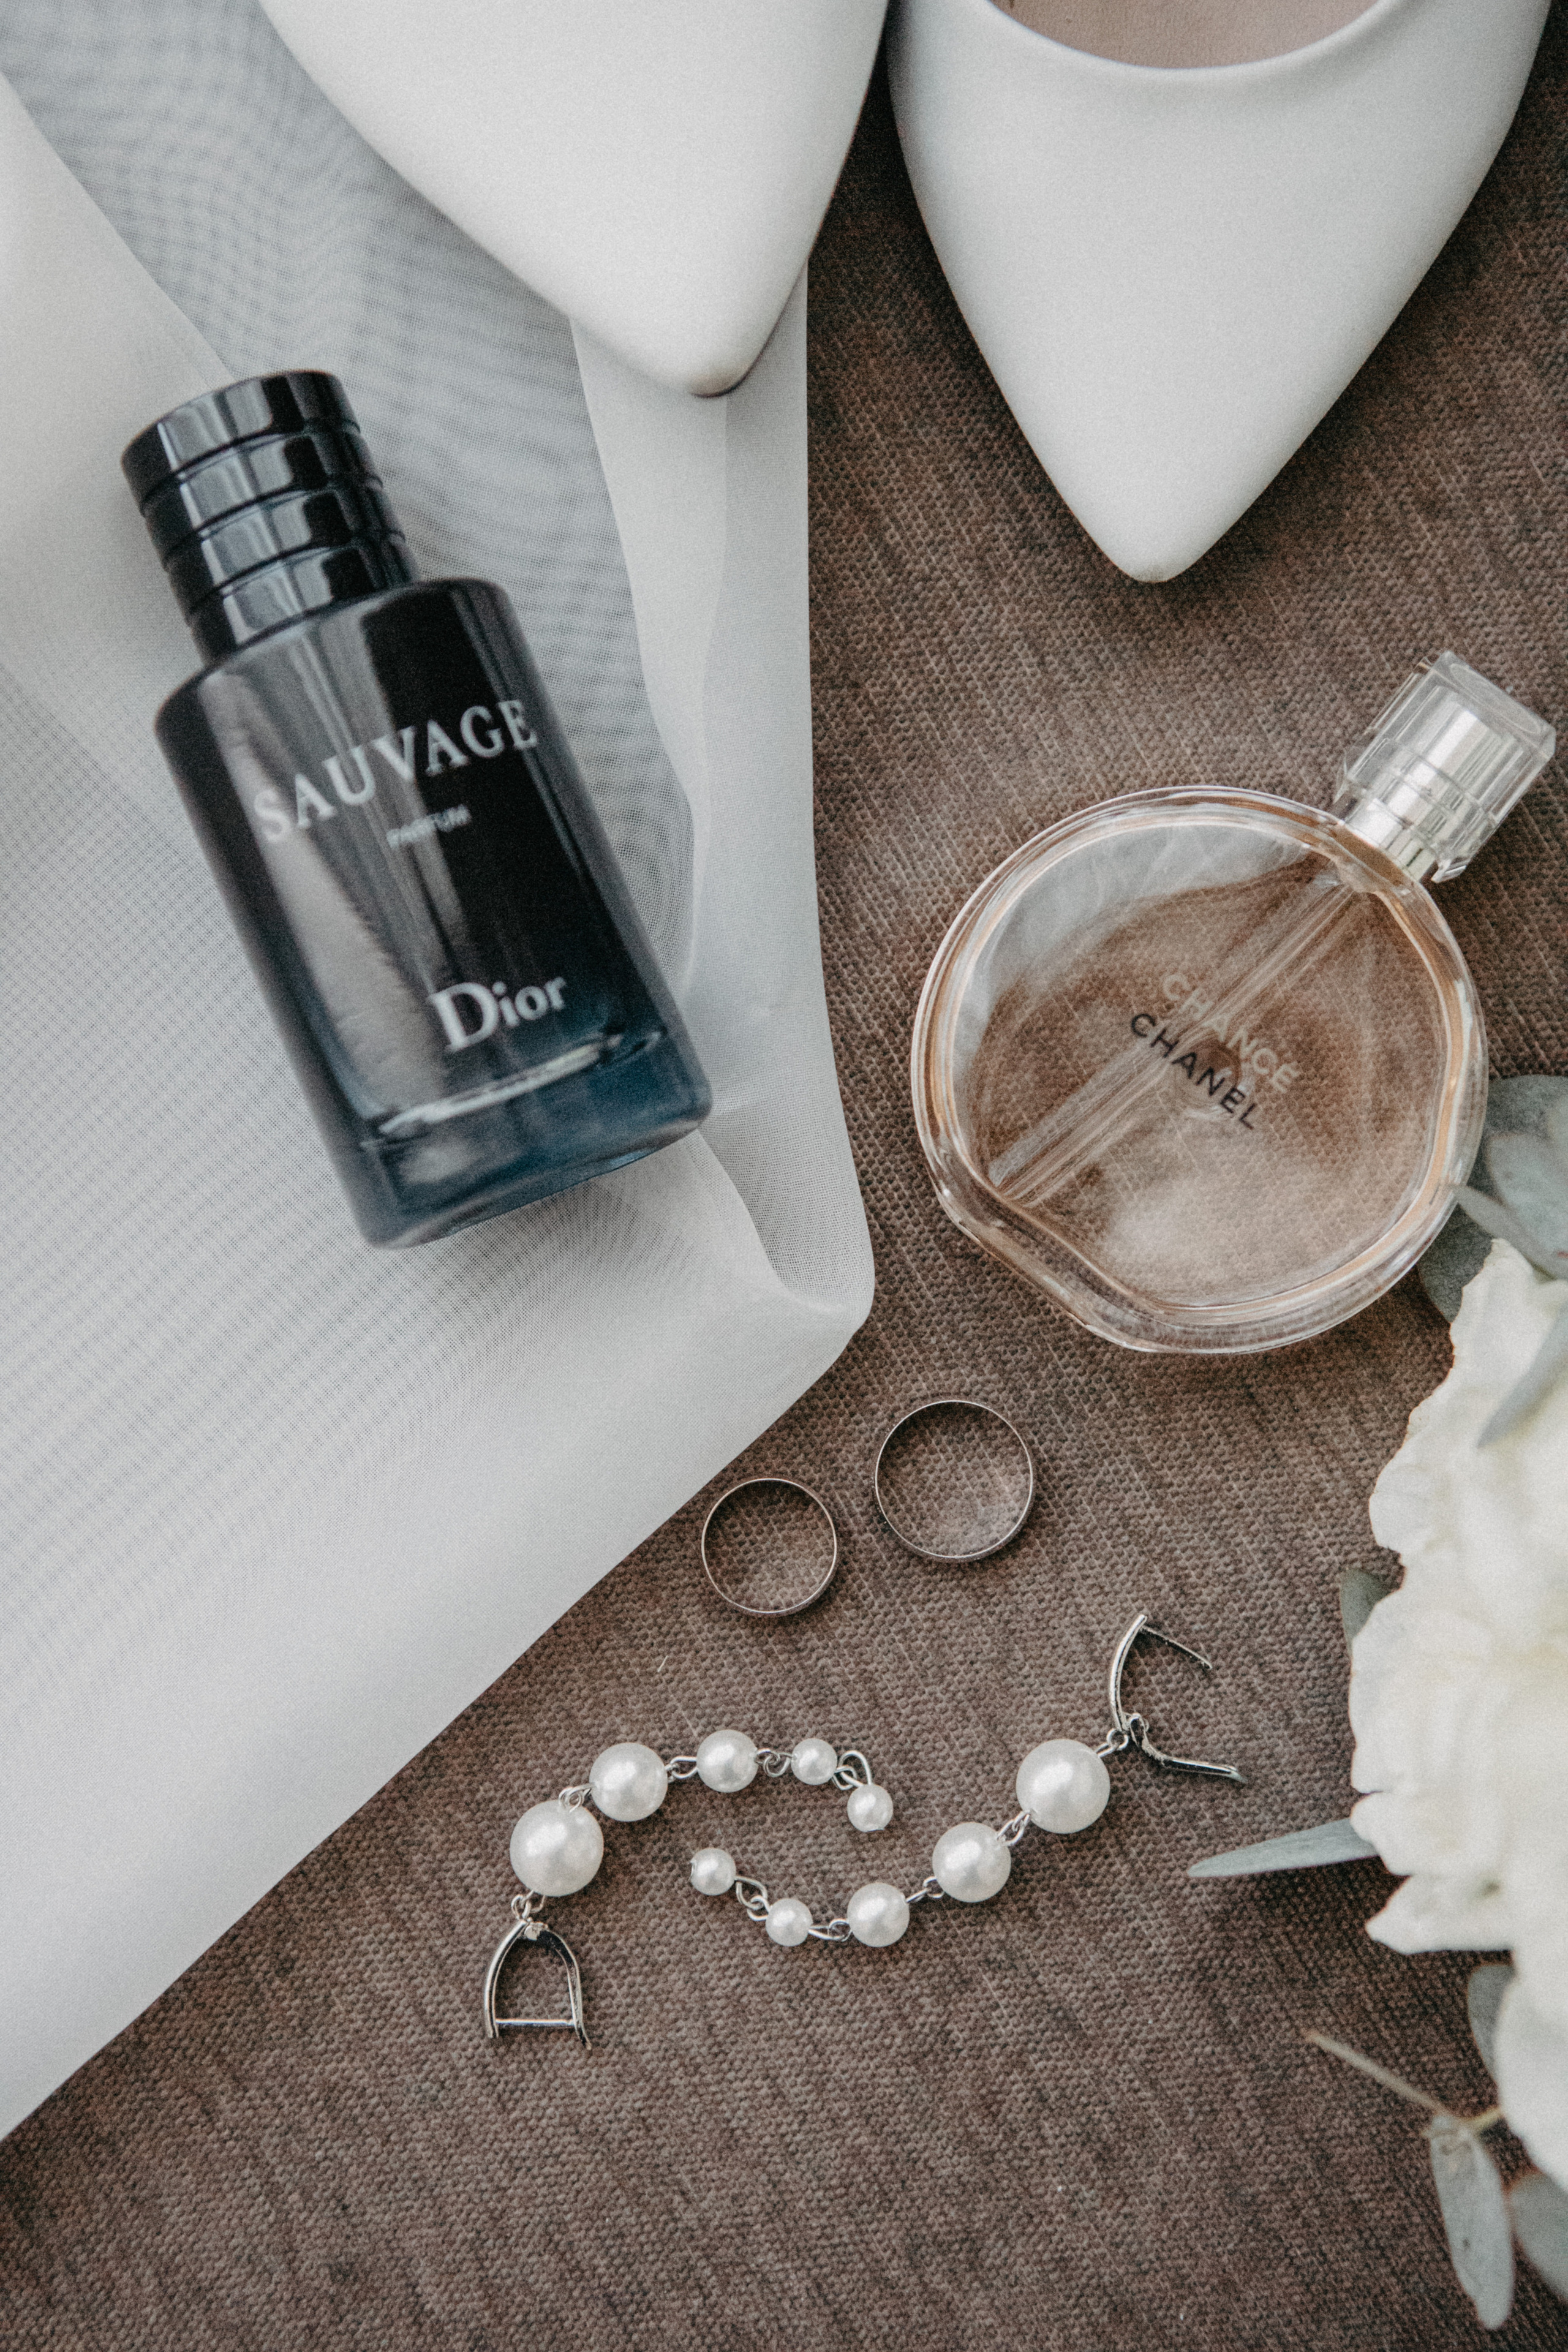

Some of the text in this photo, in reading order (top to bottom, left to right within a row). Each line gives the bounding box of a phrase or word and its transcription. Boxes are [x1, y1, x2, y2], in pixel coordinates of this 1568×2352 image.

[253, 699, 537, 843] SAUVAGE
[429, 977, 566, 1053] Dior
[1131, 1013, 1256, 1130] CHANEL
[1163, 973, 1300, 1093] CHANCE
